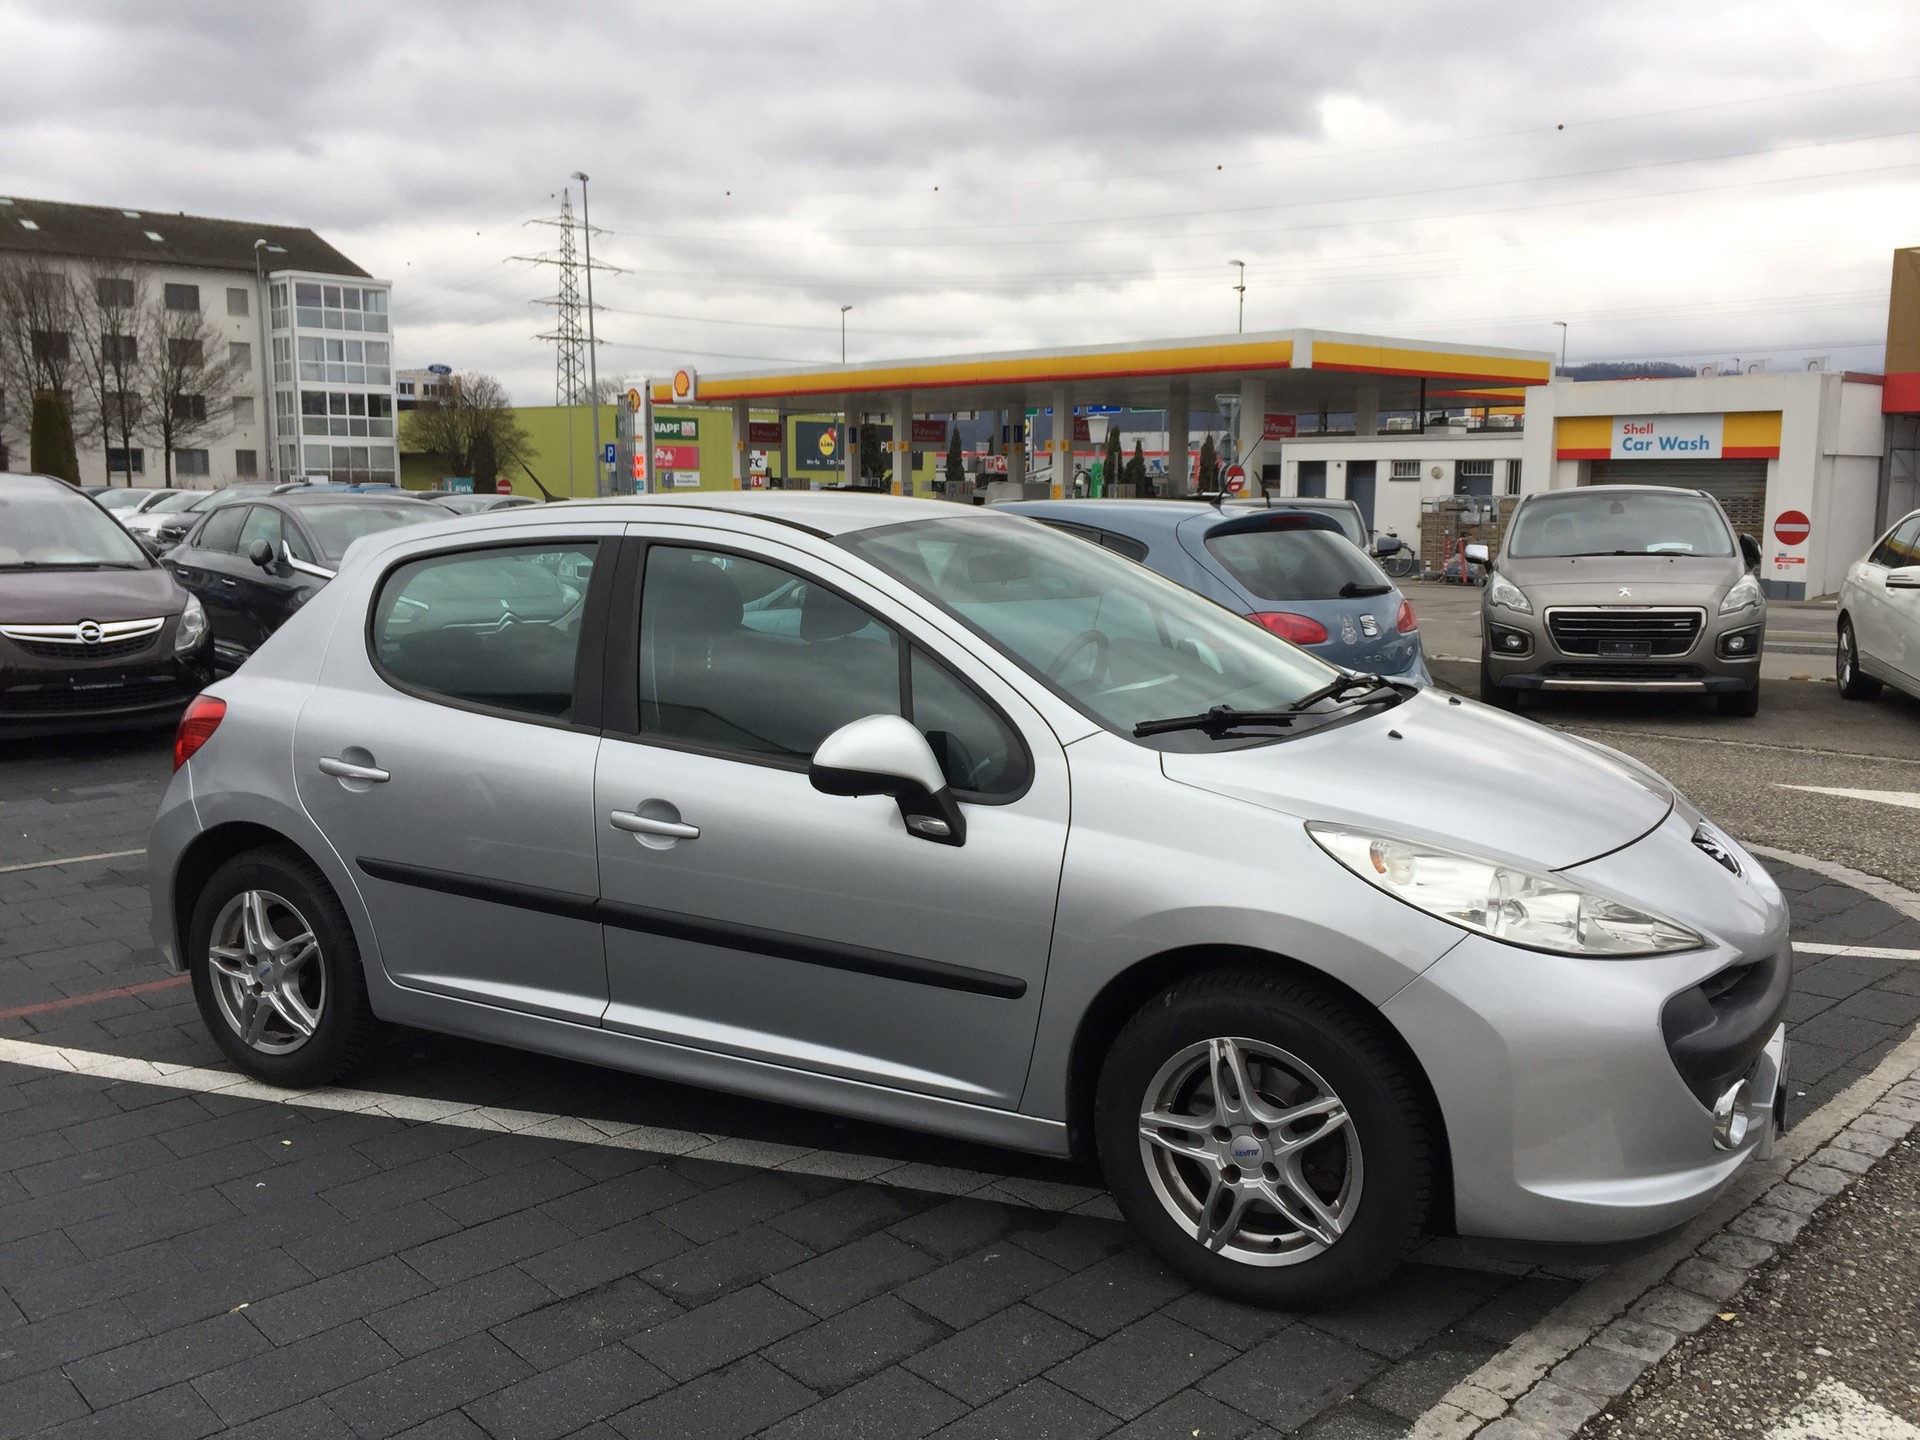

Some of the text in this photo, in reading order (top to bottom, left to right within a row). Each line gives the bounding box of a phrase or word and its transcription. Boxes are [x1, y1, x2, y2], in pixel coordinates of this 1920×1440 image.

[1623, 423, 1654, 434] Shell
[1622, 435, 1710, 451] Car Wash
[607, 446, 613, 461] P
[749, 458, 763, 468] FC
